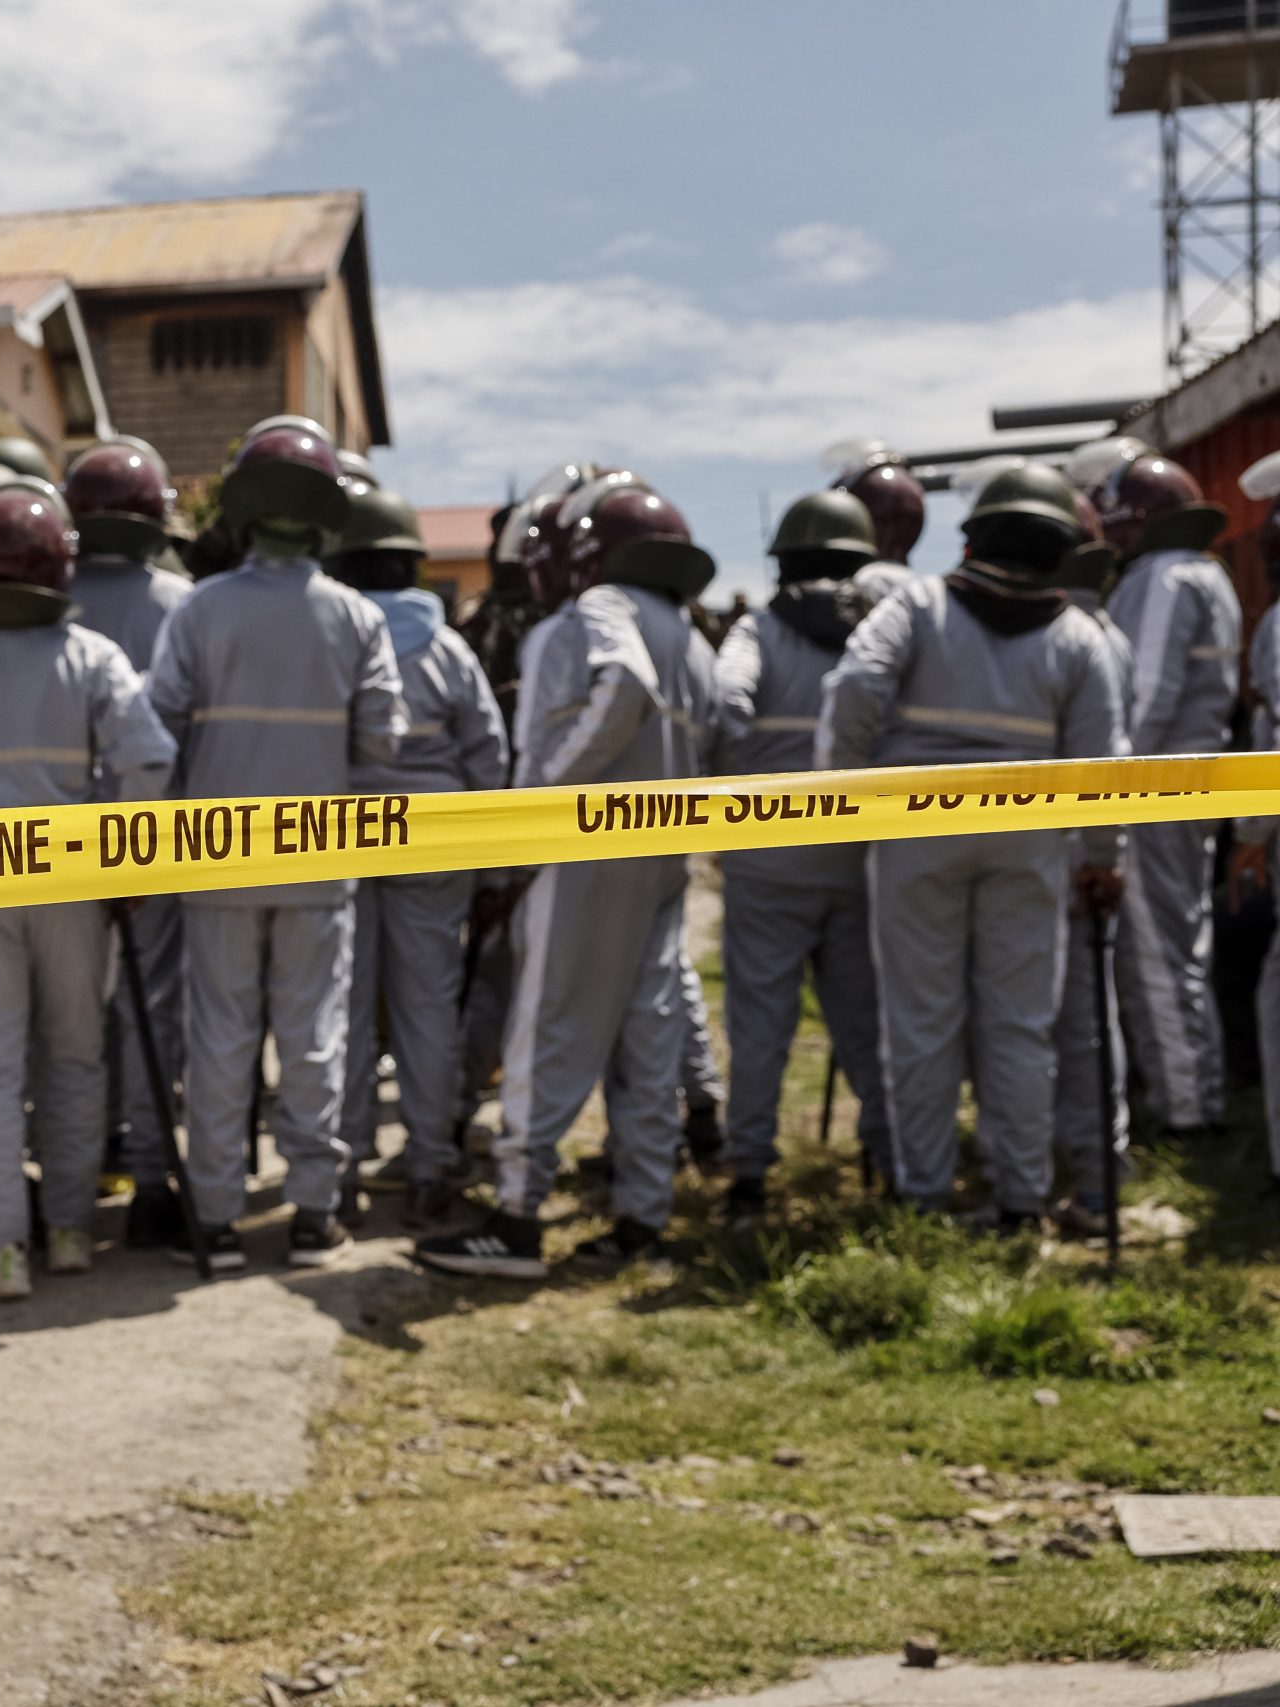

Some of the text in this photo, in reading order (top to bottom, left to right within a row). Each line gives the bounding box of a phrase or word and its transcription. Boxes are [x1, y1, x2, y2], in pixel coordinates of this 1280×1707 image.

[99, 811, 158, 869] DO
[174, 804, 257, 863] NOT
[273, 795, 409, 855] ENTER
